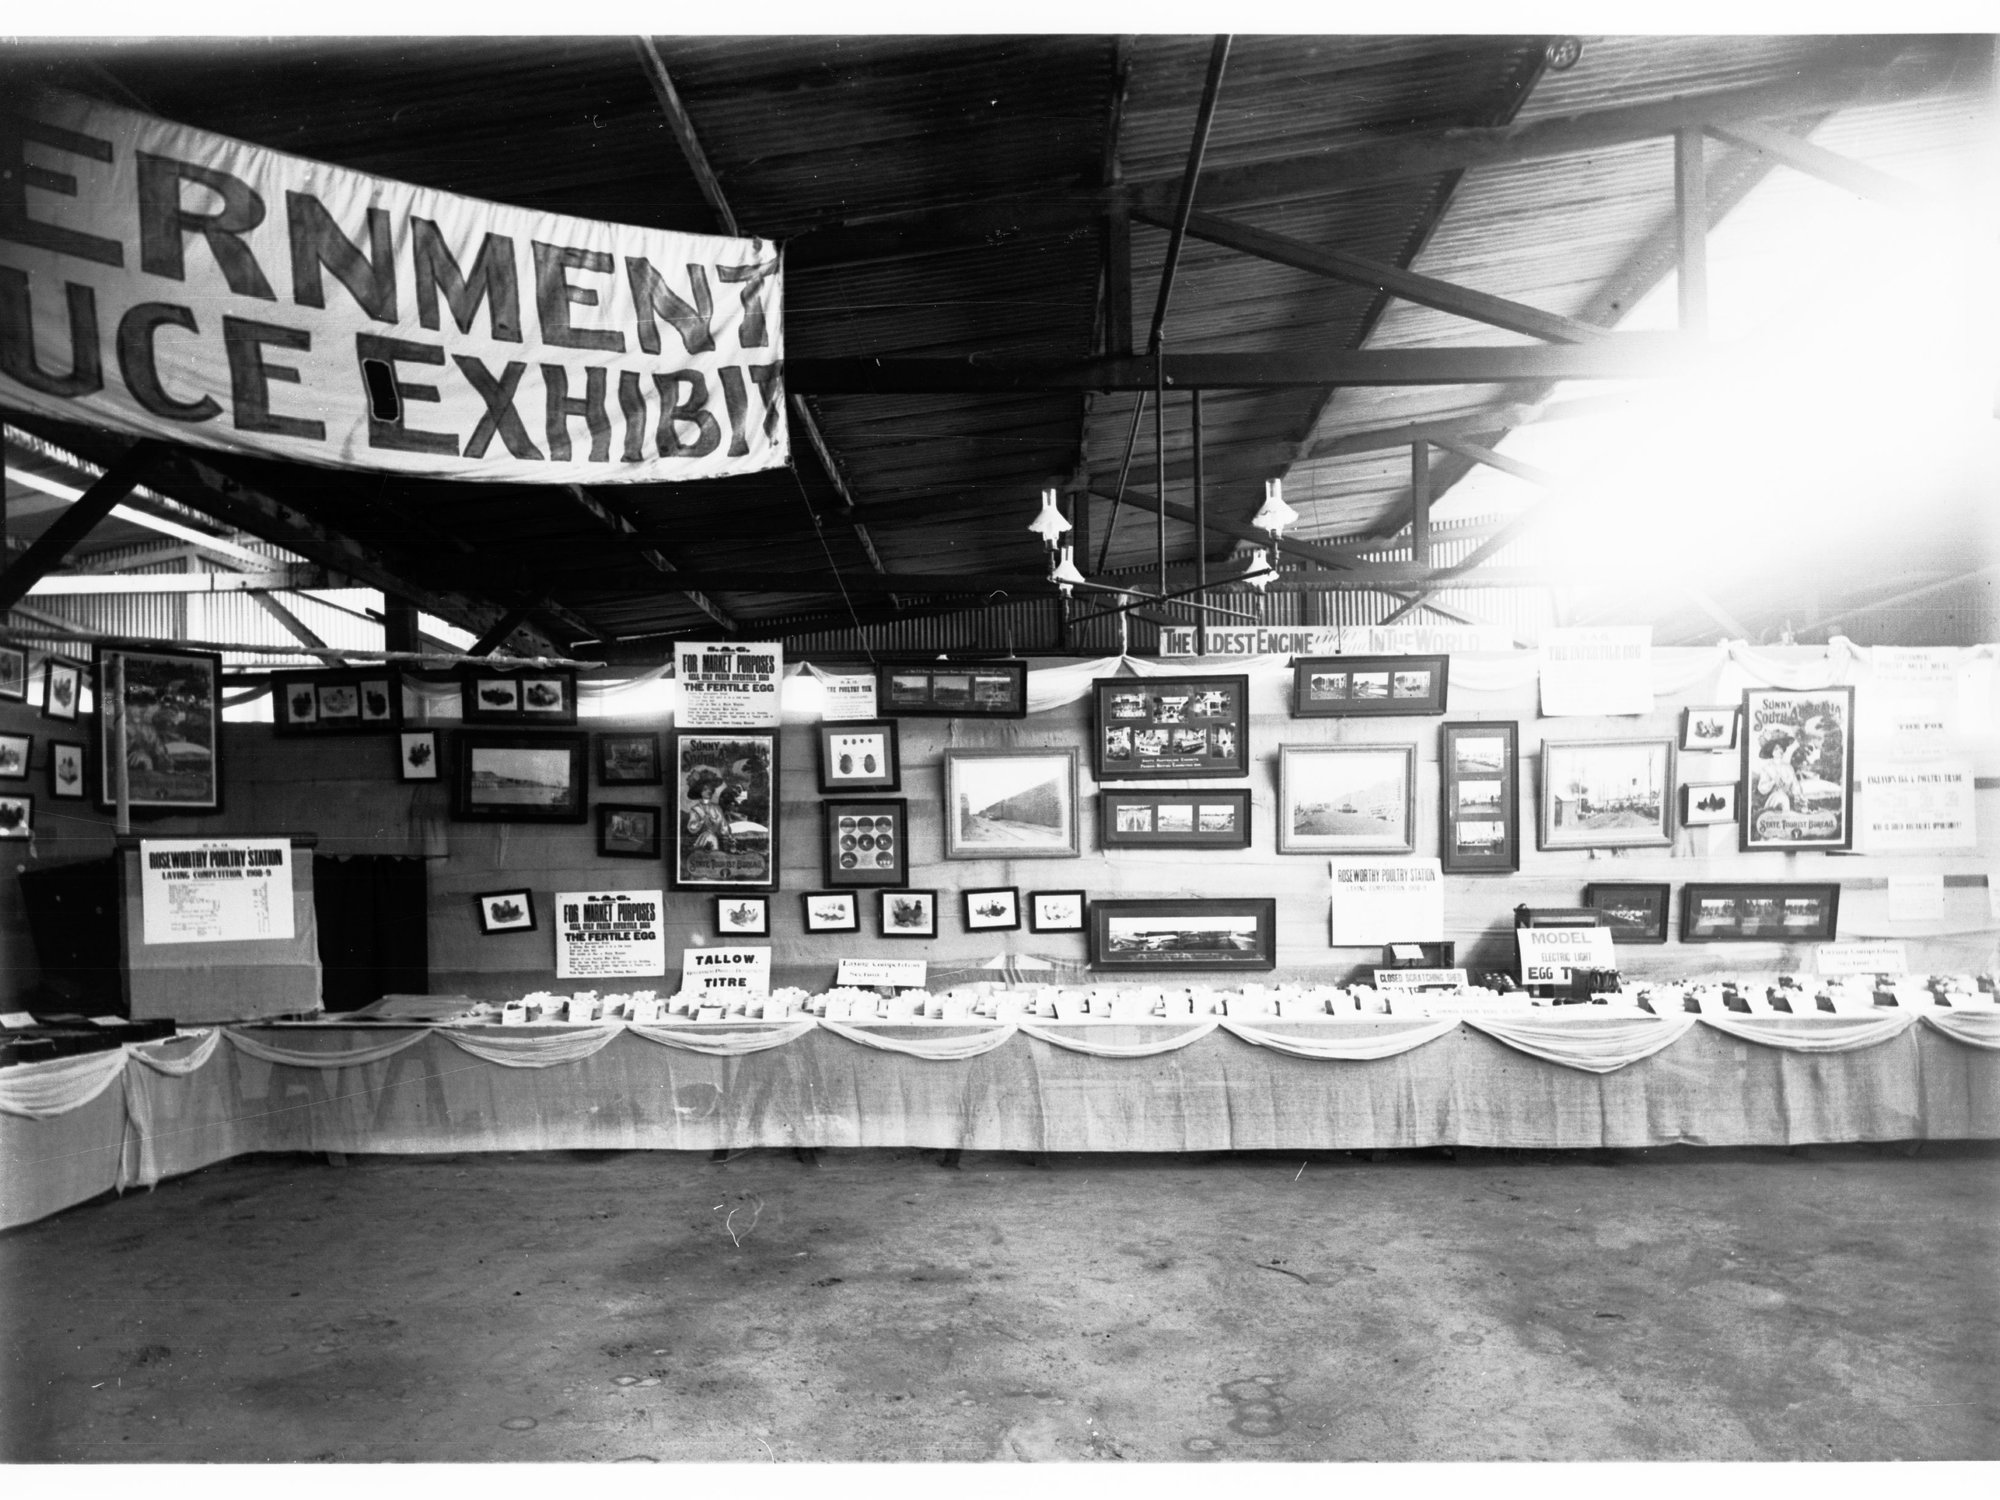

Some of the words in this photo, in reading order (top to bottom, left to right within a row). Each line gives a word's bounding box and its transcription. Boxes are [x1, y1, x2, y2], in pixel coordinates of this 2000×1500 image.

[357, 332, 784, 463] EXHIBIT
[1163, 628, 1192, 654] THE
[1257, 629, 1313, 654] ENGINE
[1369, 628, 1384, 652] IN
[682, 654, 698, 673] FOR
[702, 654, 732, 673] MARKET
[737, 655, 775, 674] PURPOSES
[683, 683, 704, 692] THE
[707, 683, 750, 692] FERTILE
[753, 684, 775, 693] EGG
[690, 739, 720, 752] SUNNY
[149, 850, 208, 870] ROSEWORTHY
[209, 850, 246, 869] POULTRY
[247, 849, 283, 867] STATION
[193, 869, 242, 880] COMPETITION
[1337, 868, 1379, 883] ROSEWORTHY
[1381, 868, 1408, 882] POULTRY
[1410, 868, 1436, 882] STATION
[563, 904, 579, 923] FOR
[583, 904, 613, 923] MARKET
[618, 903, 656, 922] PURPOSES
[565, 933, 586, 942] THE
[588, 932, 631, 941] FERTILE
[633, 932, 656, 941] EGG
[1531, 932, 1593, 944] MODEL
[1541, 952, 1571, 963] ELECTRIC
[1528, 966, 1553, 980] EGG
[704, 977, 747, 988] TITRE
